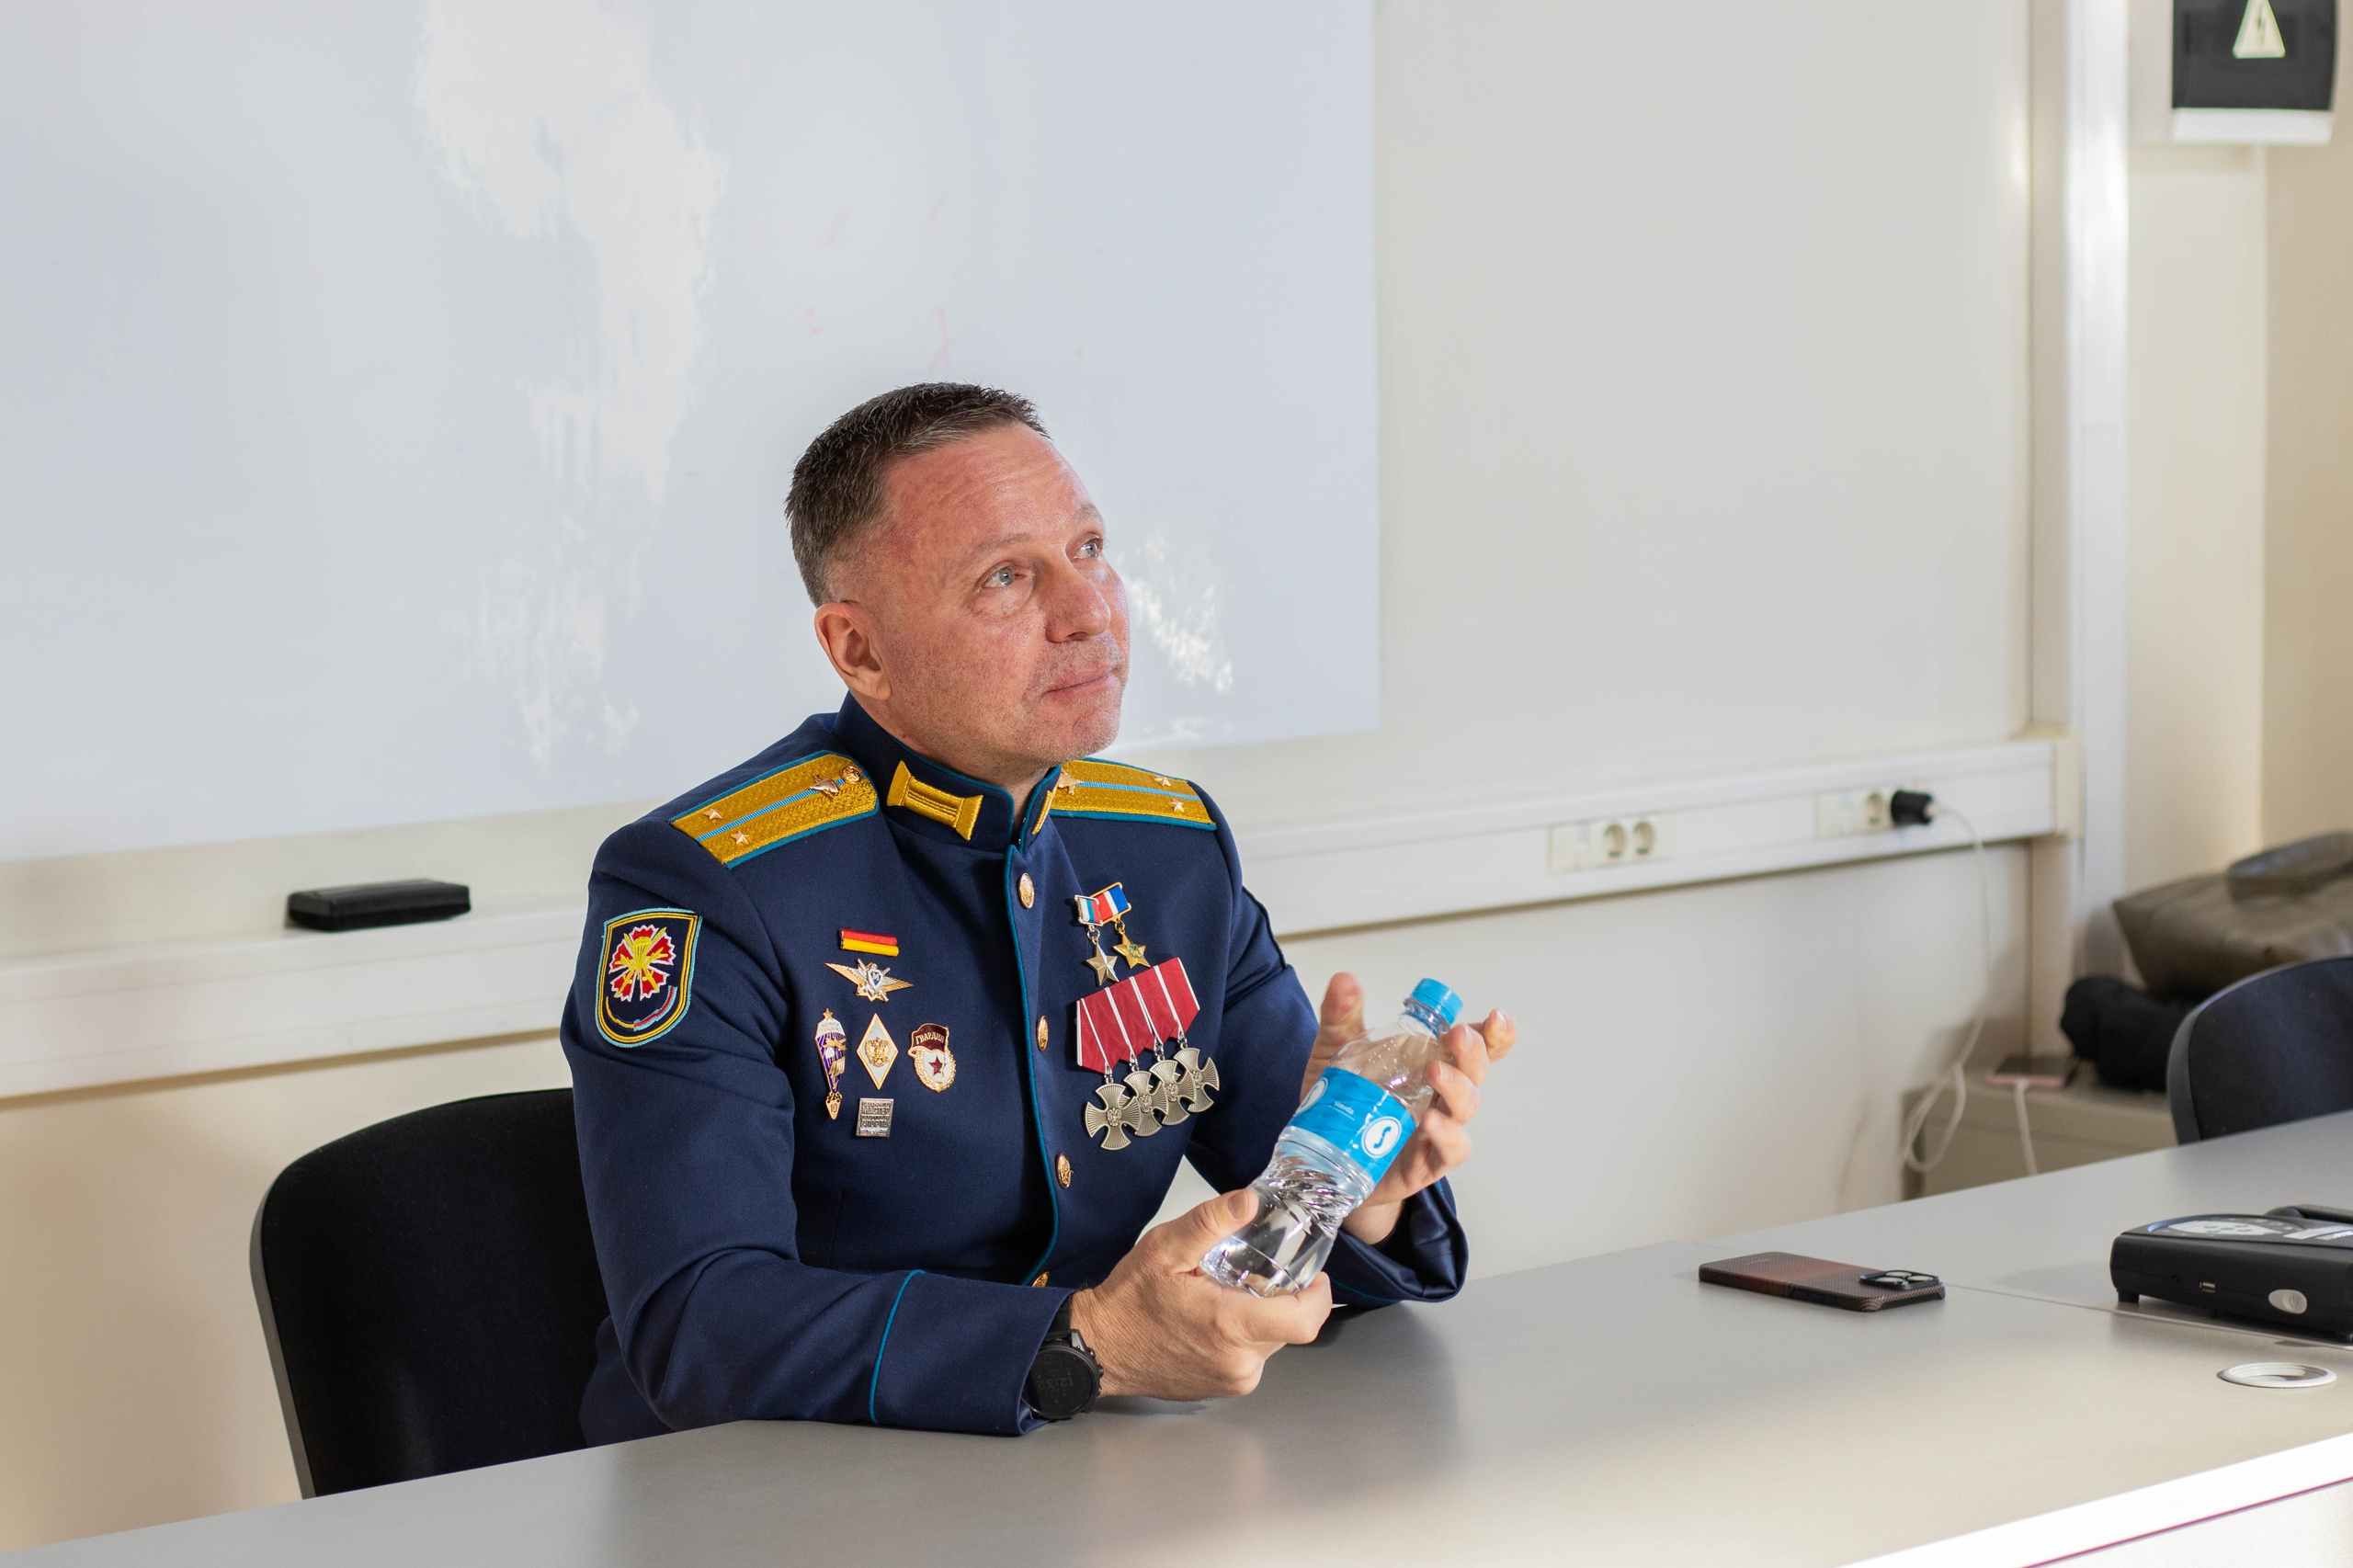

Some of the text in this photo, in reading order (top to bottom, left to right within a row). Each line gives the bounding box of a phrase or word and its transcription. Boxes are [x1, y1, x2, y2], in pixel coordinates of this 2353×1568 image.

[915, 1031, 945, 1044] ГВАРДИЯ
[830, 1103, 838, 1113] 10
[1334, 1101, 1354, 1115] slavda
